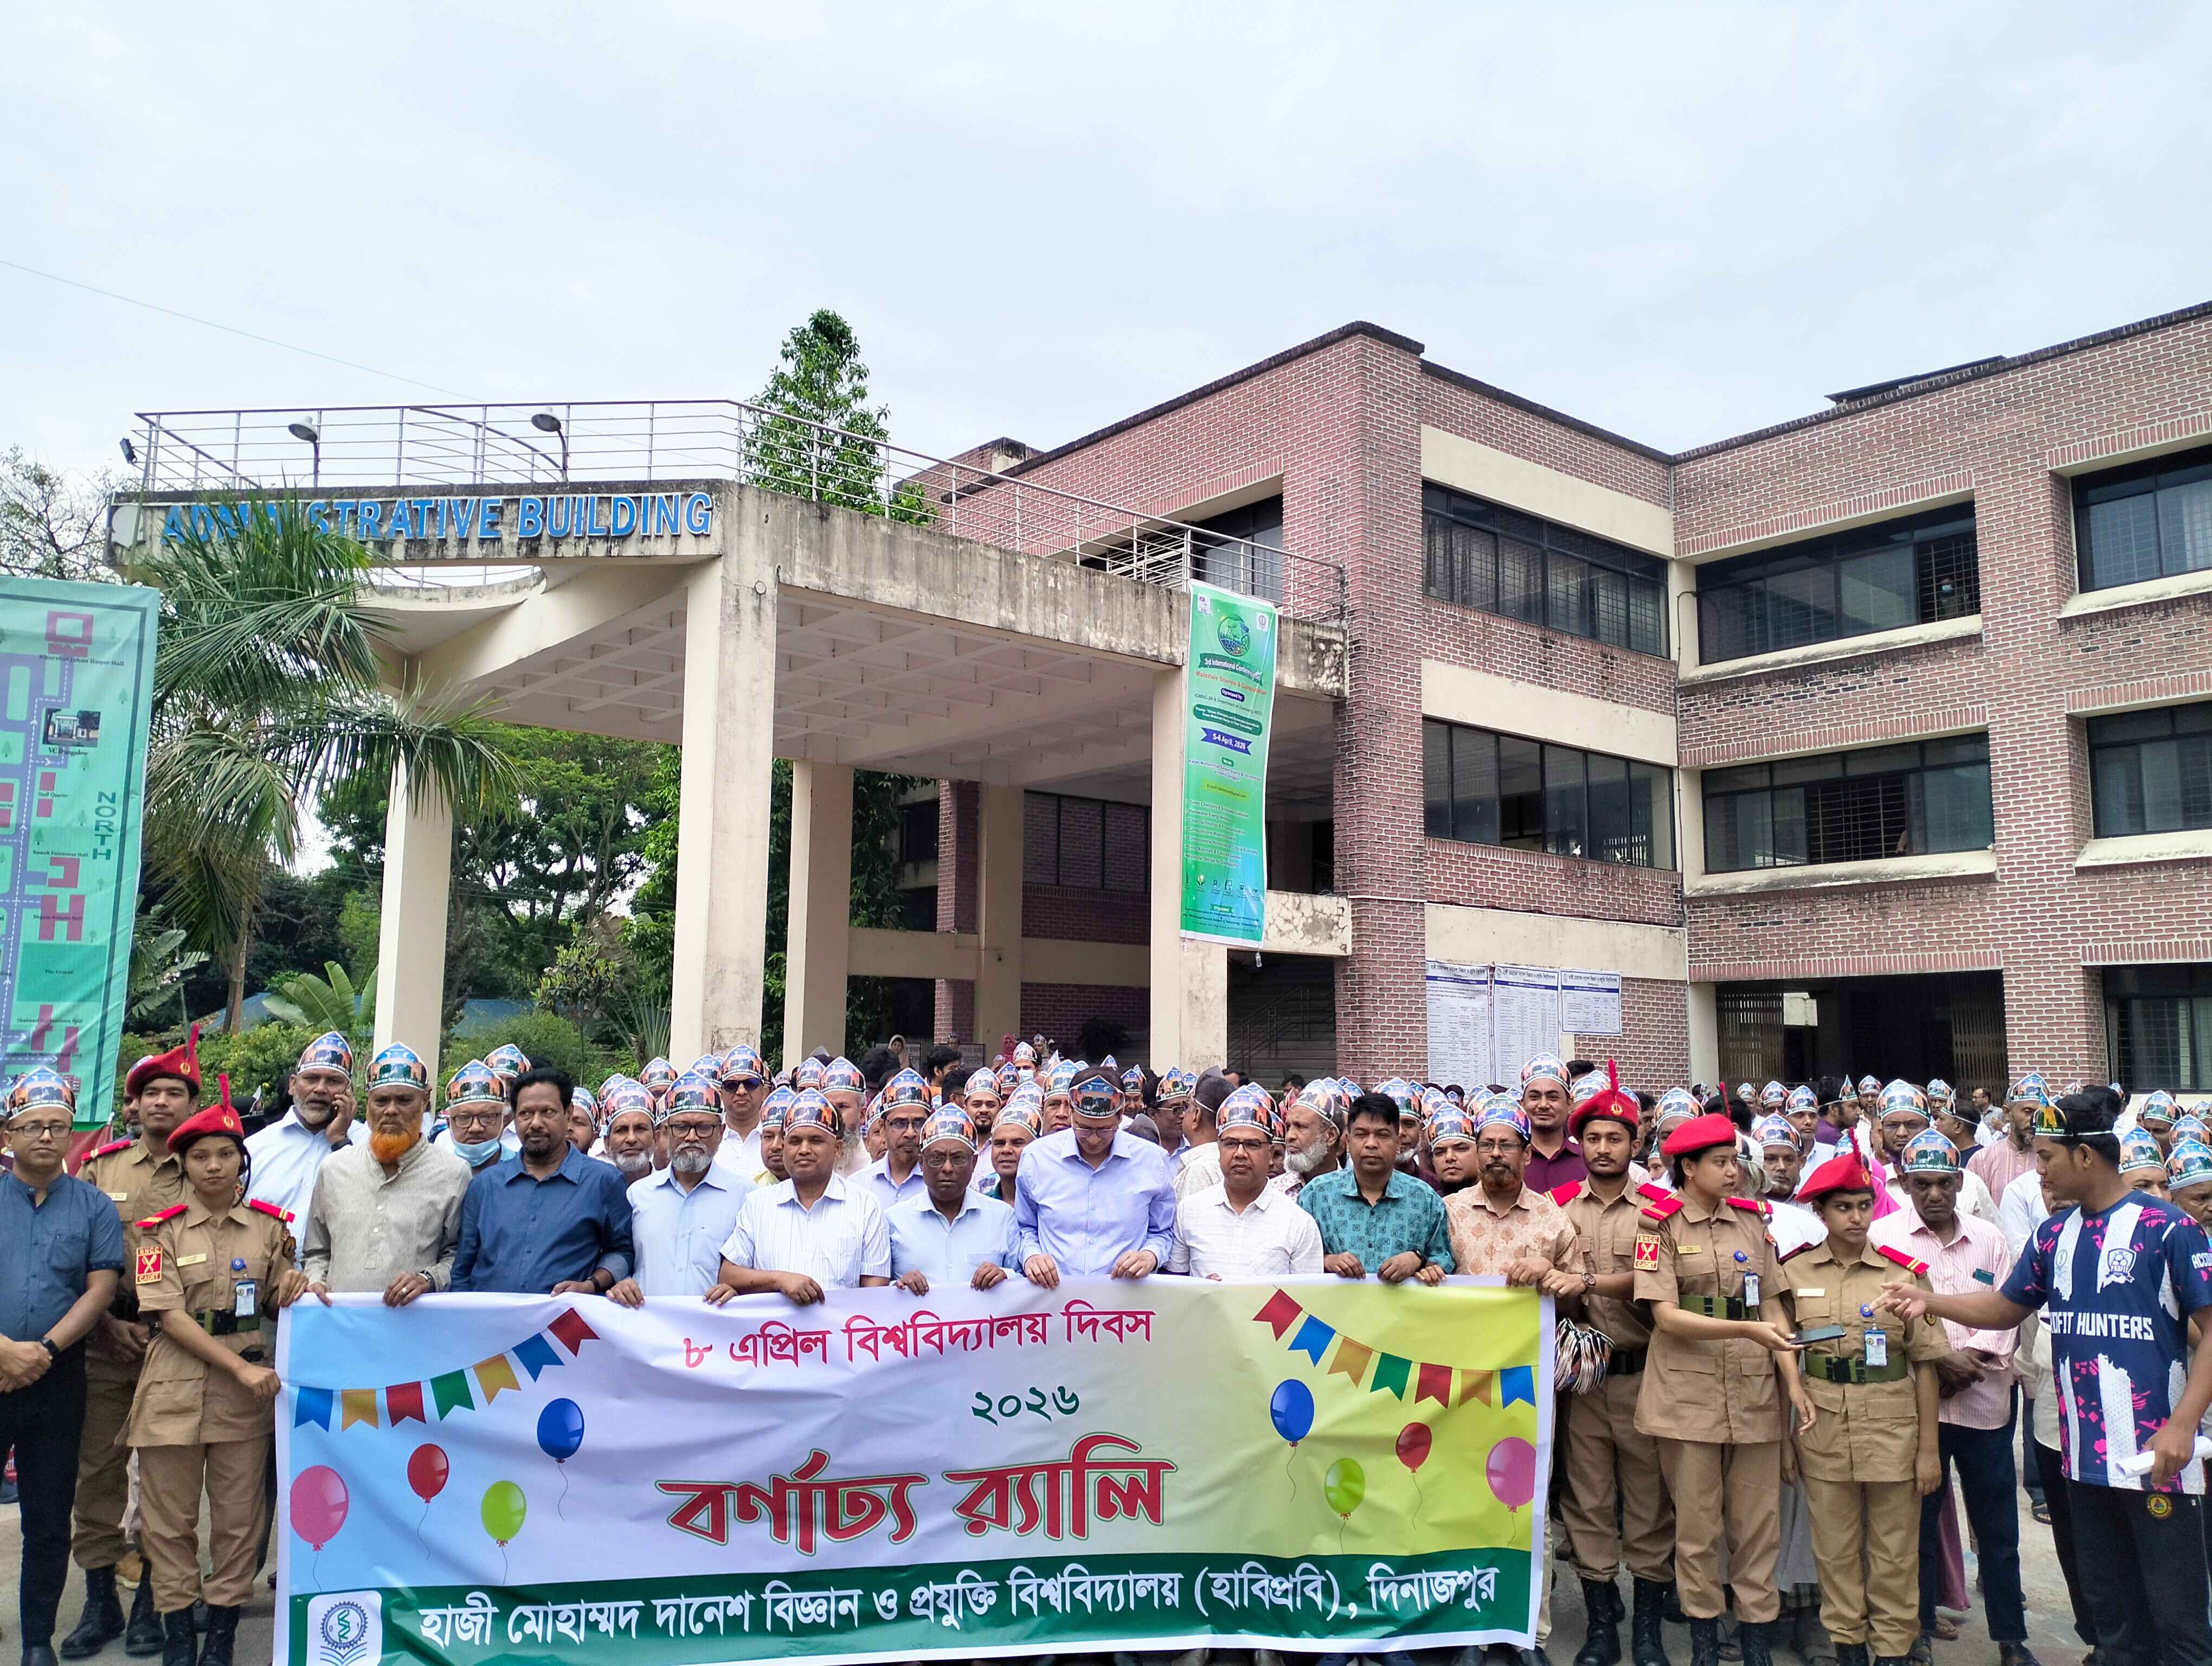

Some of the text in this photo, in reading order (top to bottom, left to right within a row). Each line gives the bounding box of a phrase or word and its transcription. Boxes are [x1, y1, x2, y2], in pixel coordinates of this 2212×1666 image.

[518, 491, 713, 539] BUILDING
[1195, 670, 1218, 680] Materials
[1219, 676, 1237, 686] Science
[1212, 659, 1236, 669] International
[1212, 733, 1246, 750] 5-6 April, 2026
[92, 791, 116, 860] NORTH
[139, 1273, 159, 1282] CADET
[2111, 1265, 2129, 1273] PROFIT
[683, 1299, 1157, 1368] ৮ এপ্রিল বিশ্ববিদ্যালয় দিবস
[2076, 1312, 2155, 1341] HUNTERS
[971, 1385, 1080, 1427] ২০২৬
[655, 1450, 928, 1555] বর্ণাঢ্য
[417, 1591, 500, 1649] হাজী
[507, 1599, 645, 1645] মোহাম্মদ
[650, 1589, 756, 1637] দানেশ
[760, 1580, 864, 1632] বিজ্ঞান
[872, 1588, 898, 1620] ও
[909, 1569, 1000, 1630] প্রযুক্তি
[1006, 1563, 1184, 1617] বিশ্ববিদ্যালয়
[1366, 1562, 1500, 1614] দিনাজপুর
